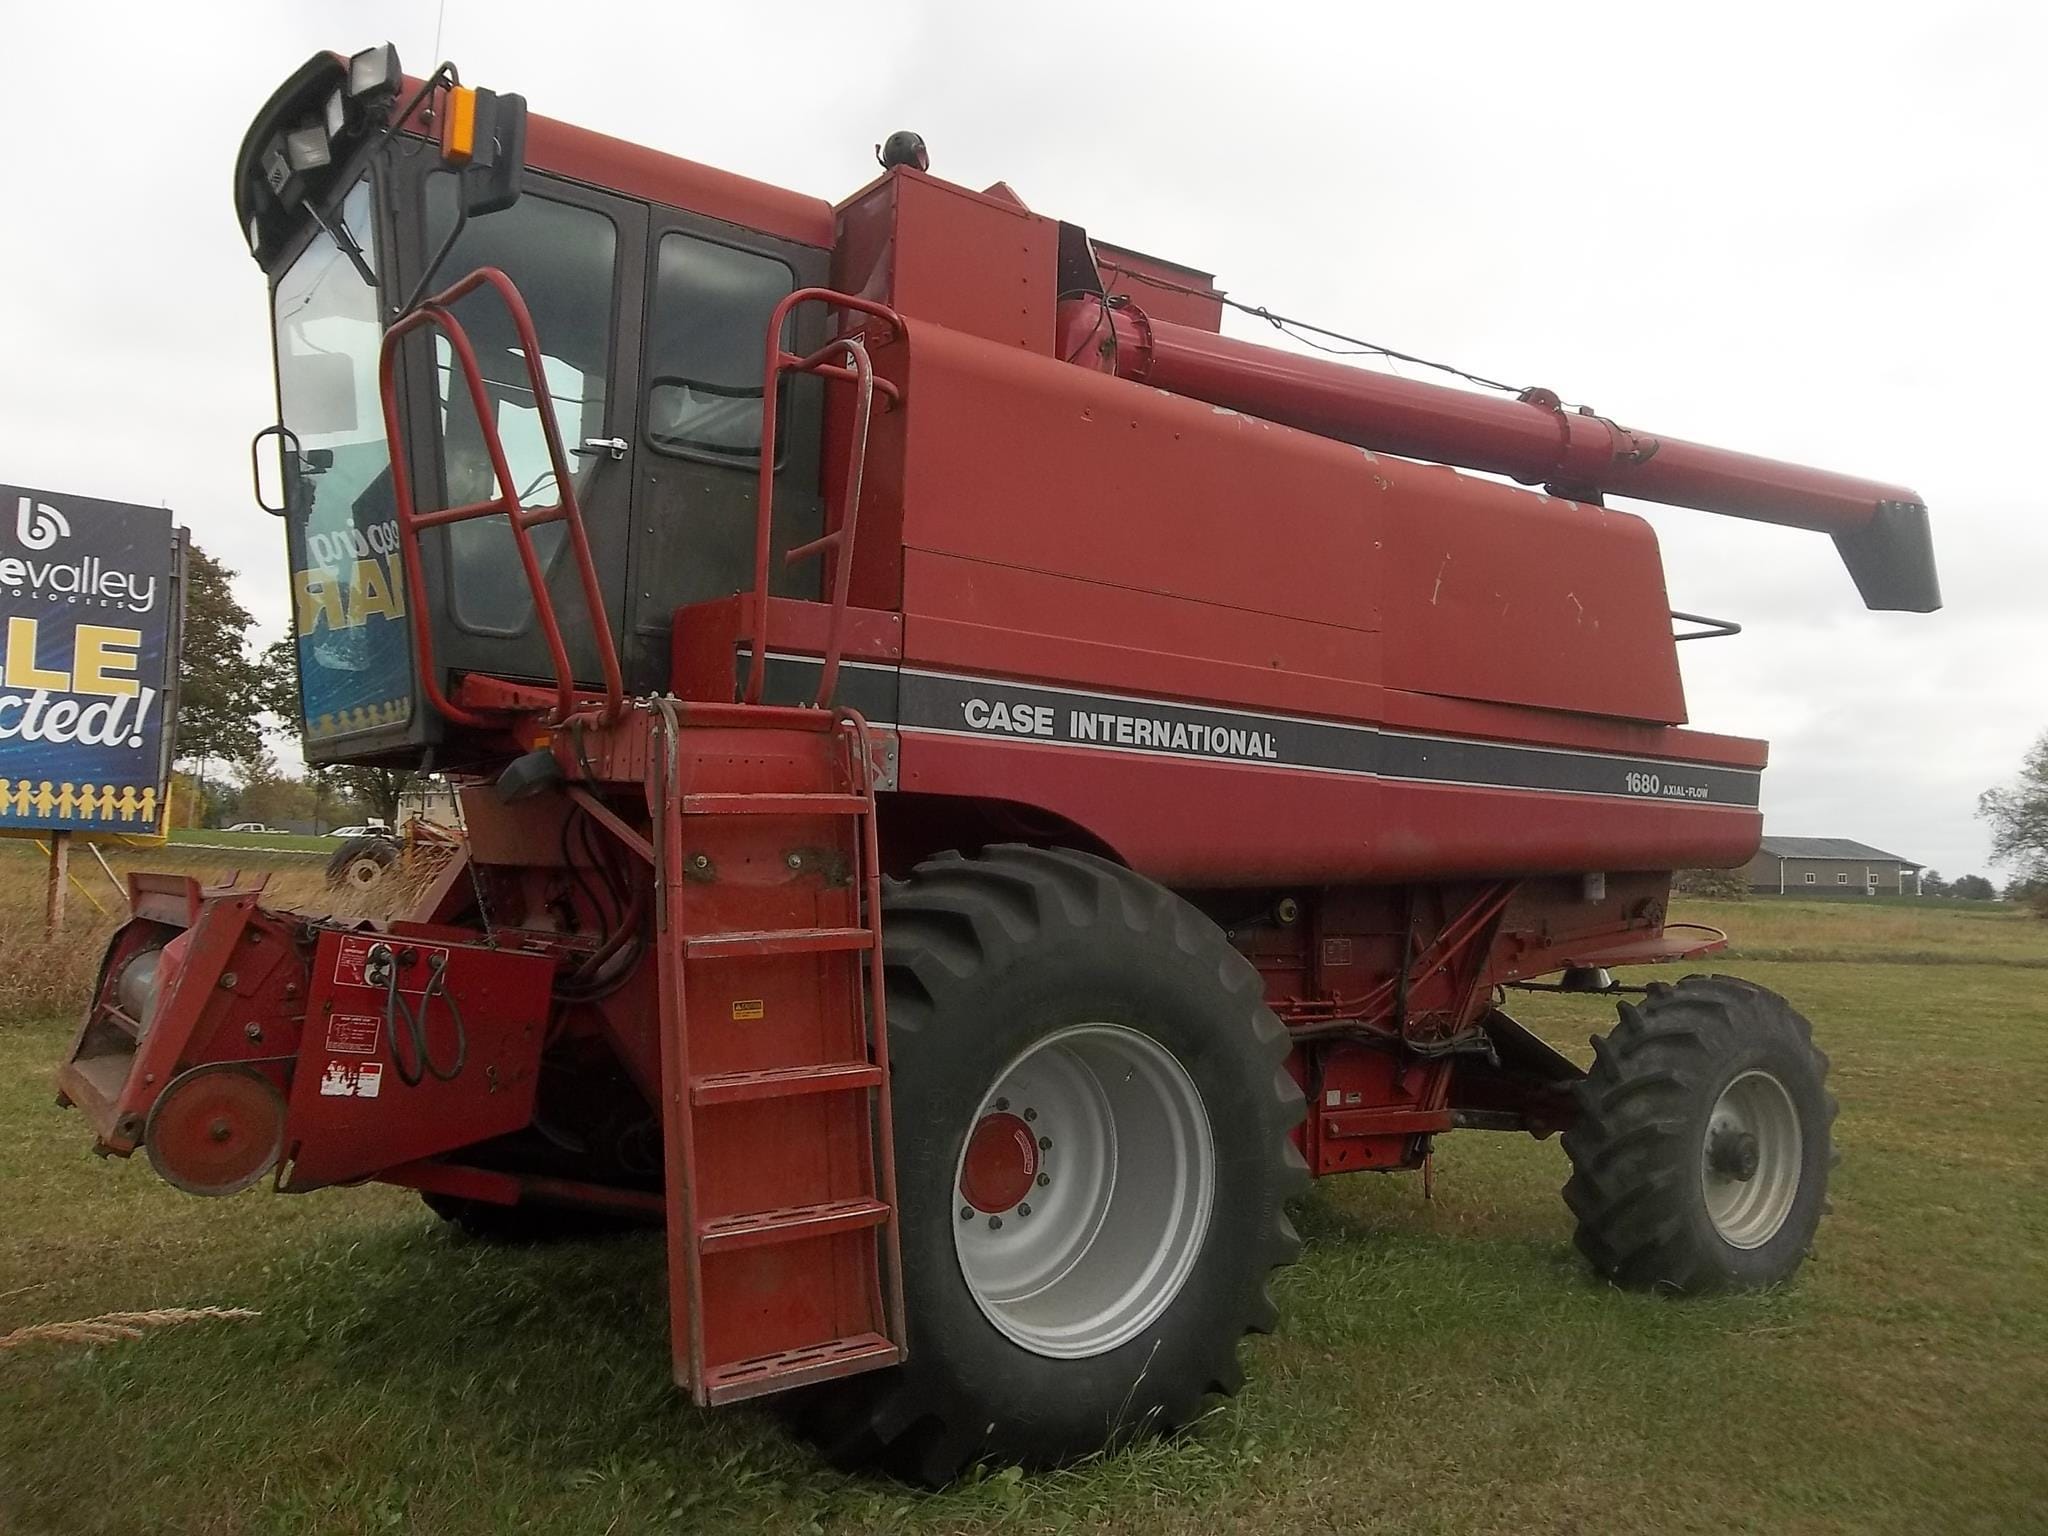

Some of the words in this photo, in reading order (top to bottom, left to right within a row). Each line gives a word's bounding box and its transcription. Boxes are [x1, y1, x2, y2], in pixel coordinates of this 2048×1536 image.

[0, 587, 124, 609] OLOGIES
[0, 616, 142, 698] LE
[0, 687, 156, 749] cted!
[963, 698, 1055, 736] CASE
[1069, 710, 1278, 759] INTERNATIONAL
[1625, 771, 1660, 794] 1680
